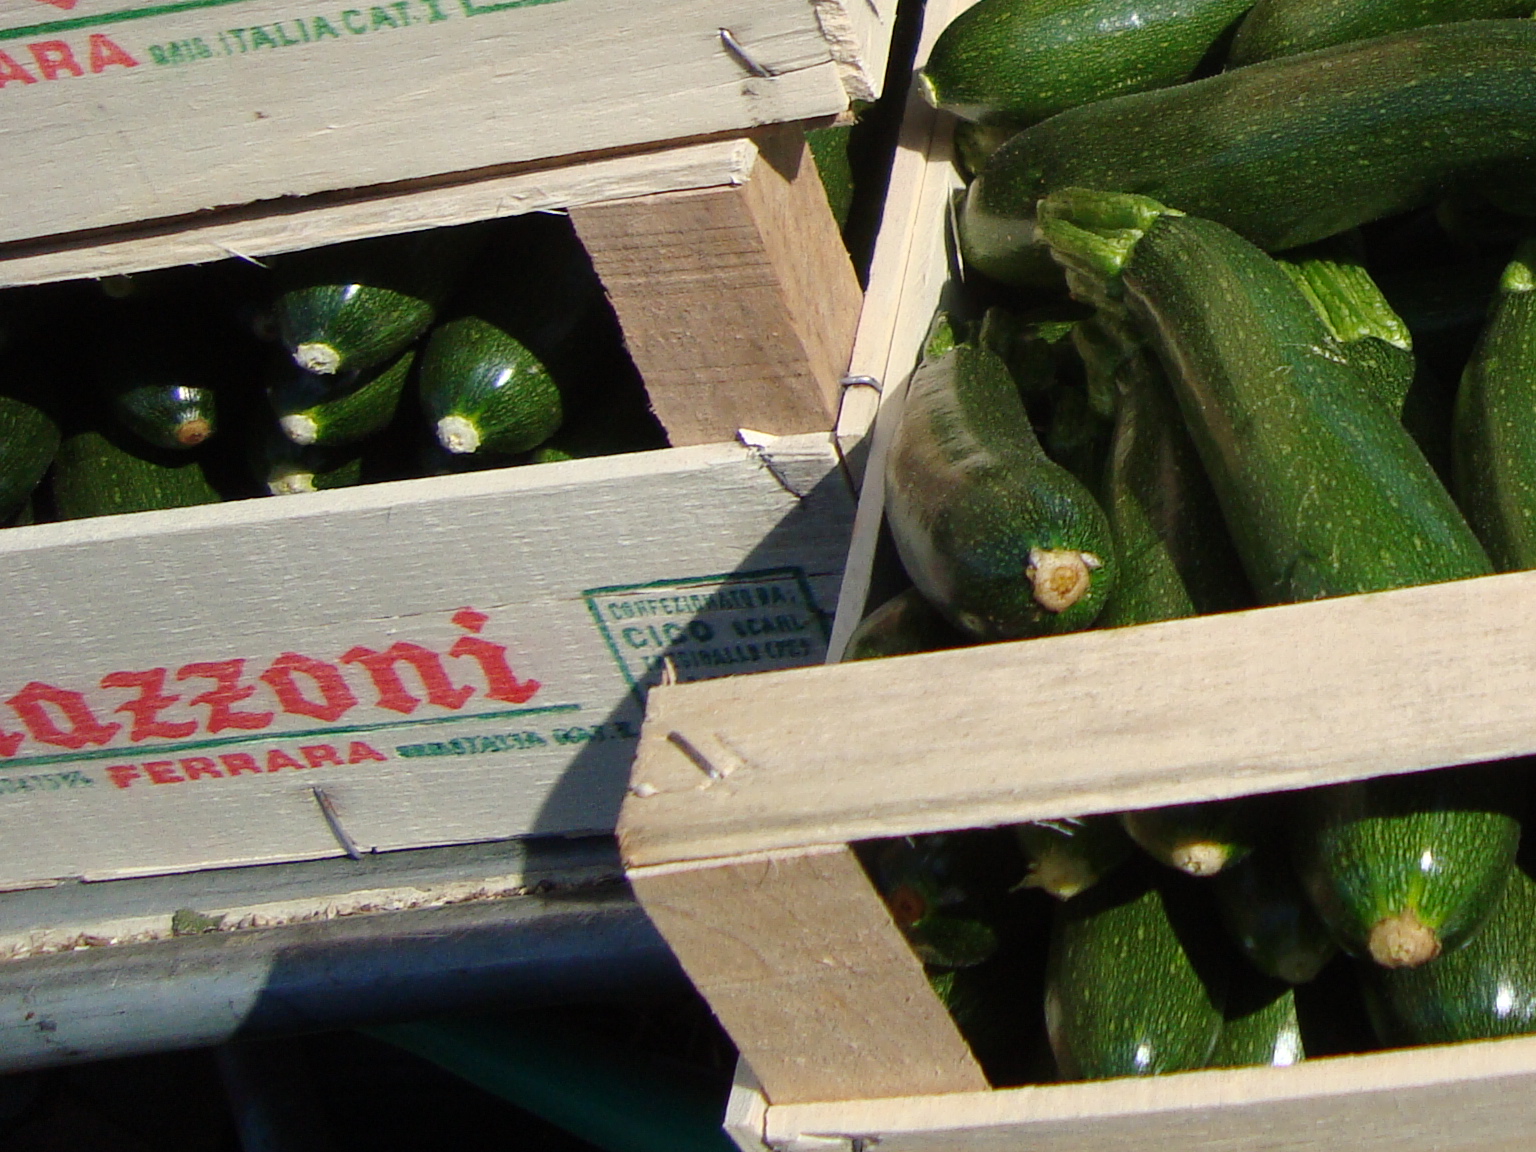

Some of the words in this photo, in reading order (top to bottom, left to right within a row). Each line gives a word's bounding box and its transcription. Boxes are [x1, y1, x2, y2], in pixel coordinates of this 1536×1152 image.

[622, 620, 715, 649] CICO
[0, 606, 541, 757] azzoni
[105, 741, 388, 789] FERRARA
